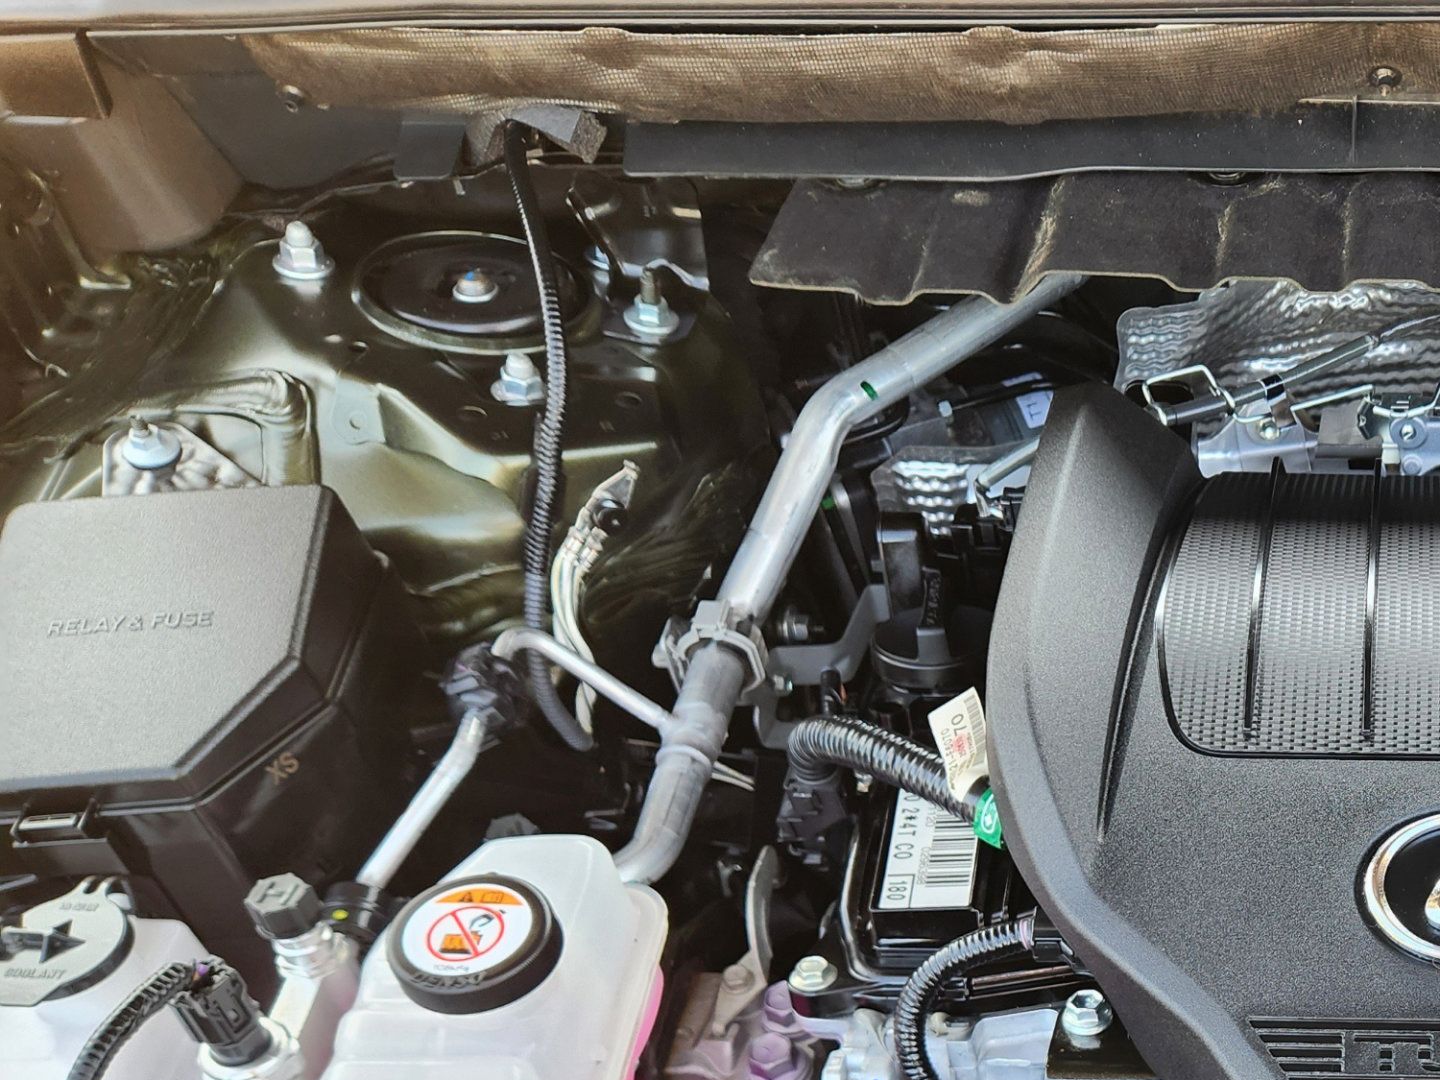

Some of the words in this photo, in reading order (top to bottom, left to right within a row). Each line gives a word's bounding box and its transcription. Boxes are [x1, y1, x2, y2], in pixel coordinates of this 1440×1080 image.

[47, 615, 126, 638] RELAY
[127, 614, 144, 632] &
[150, 610, 215, 630] FUSE
[264, 752, 299, 786] XS
[887, 880, 907, 901] 180
[4, 968, 67, 980] COOLANT
